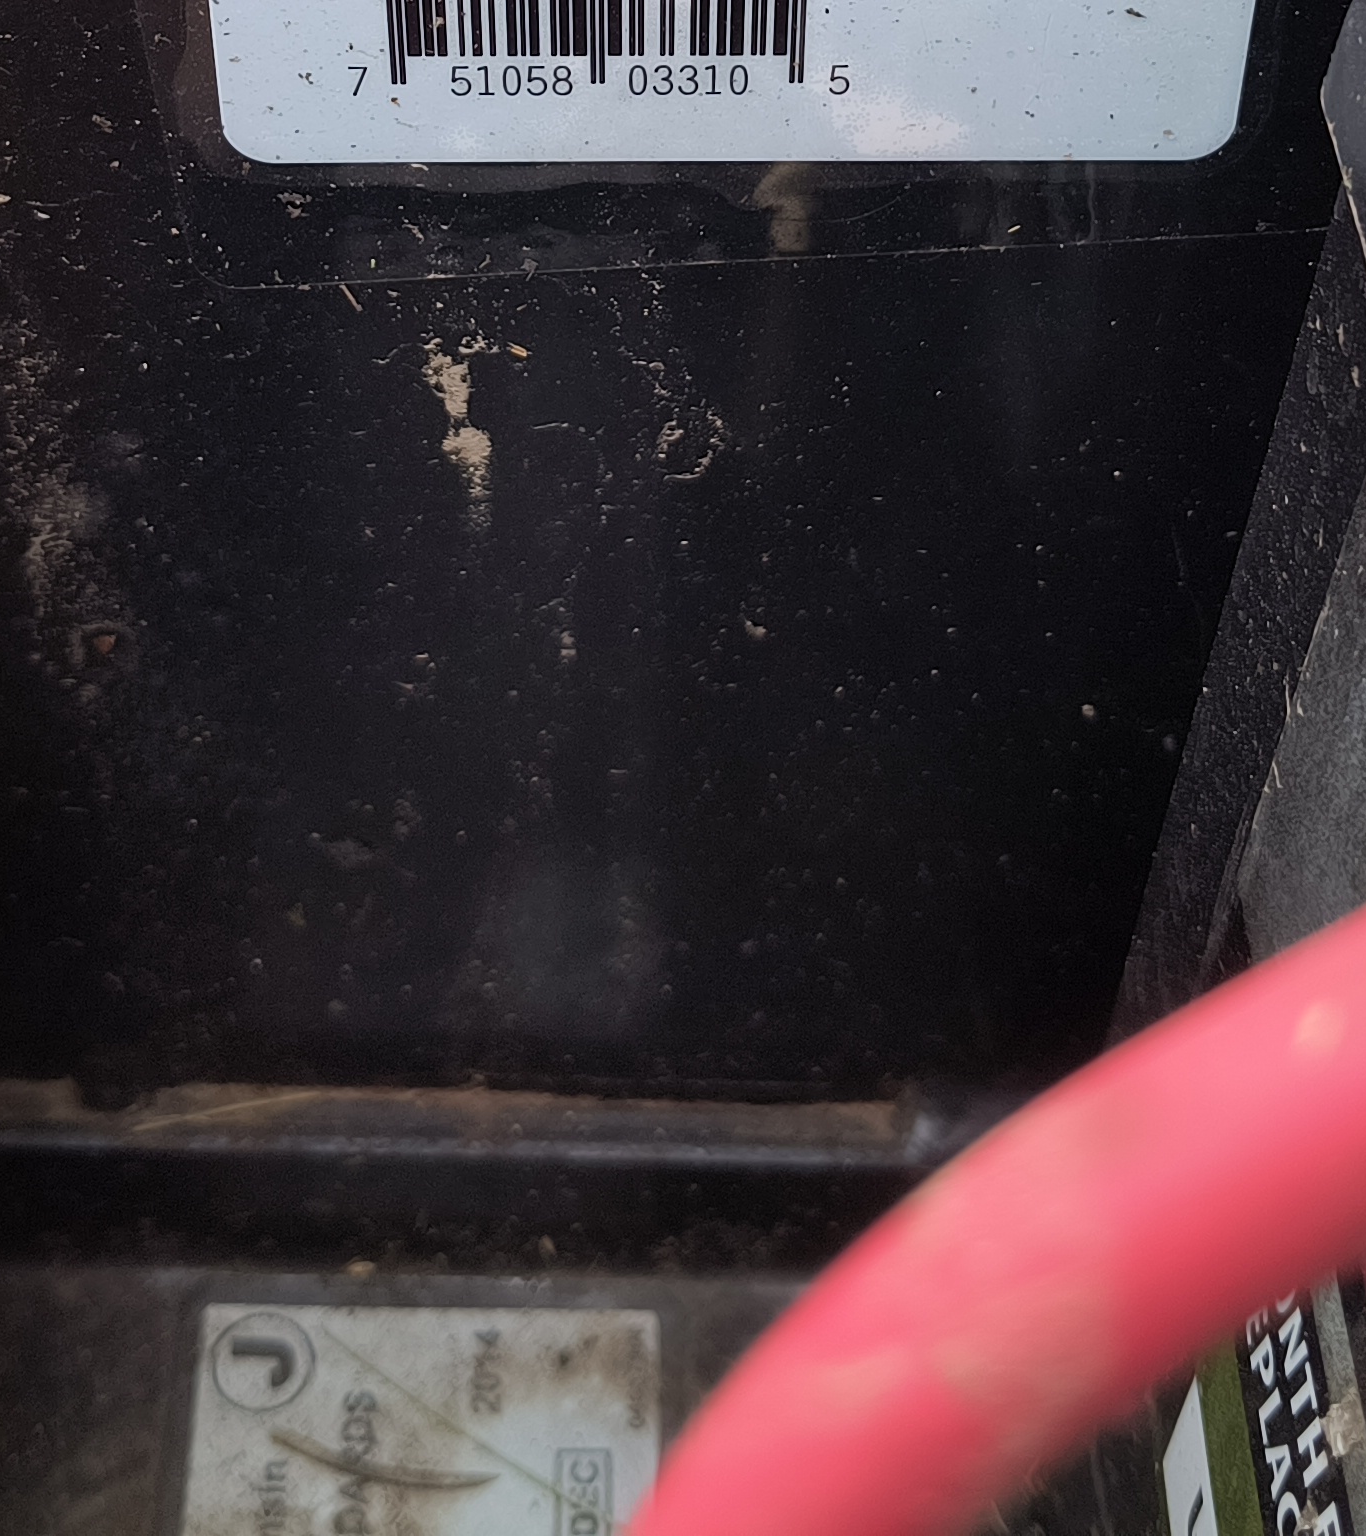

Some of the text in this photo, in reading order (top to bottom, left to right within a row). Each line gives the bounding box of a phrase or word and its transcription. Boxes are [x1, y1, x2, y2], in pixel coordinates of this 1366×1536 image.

[348, 65, 849, 96] 7 51058 03310 5
[1274, 1289, 1332, 1490] NTH
